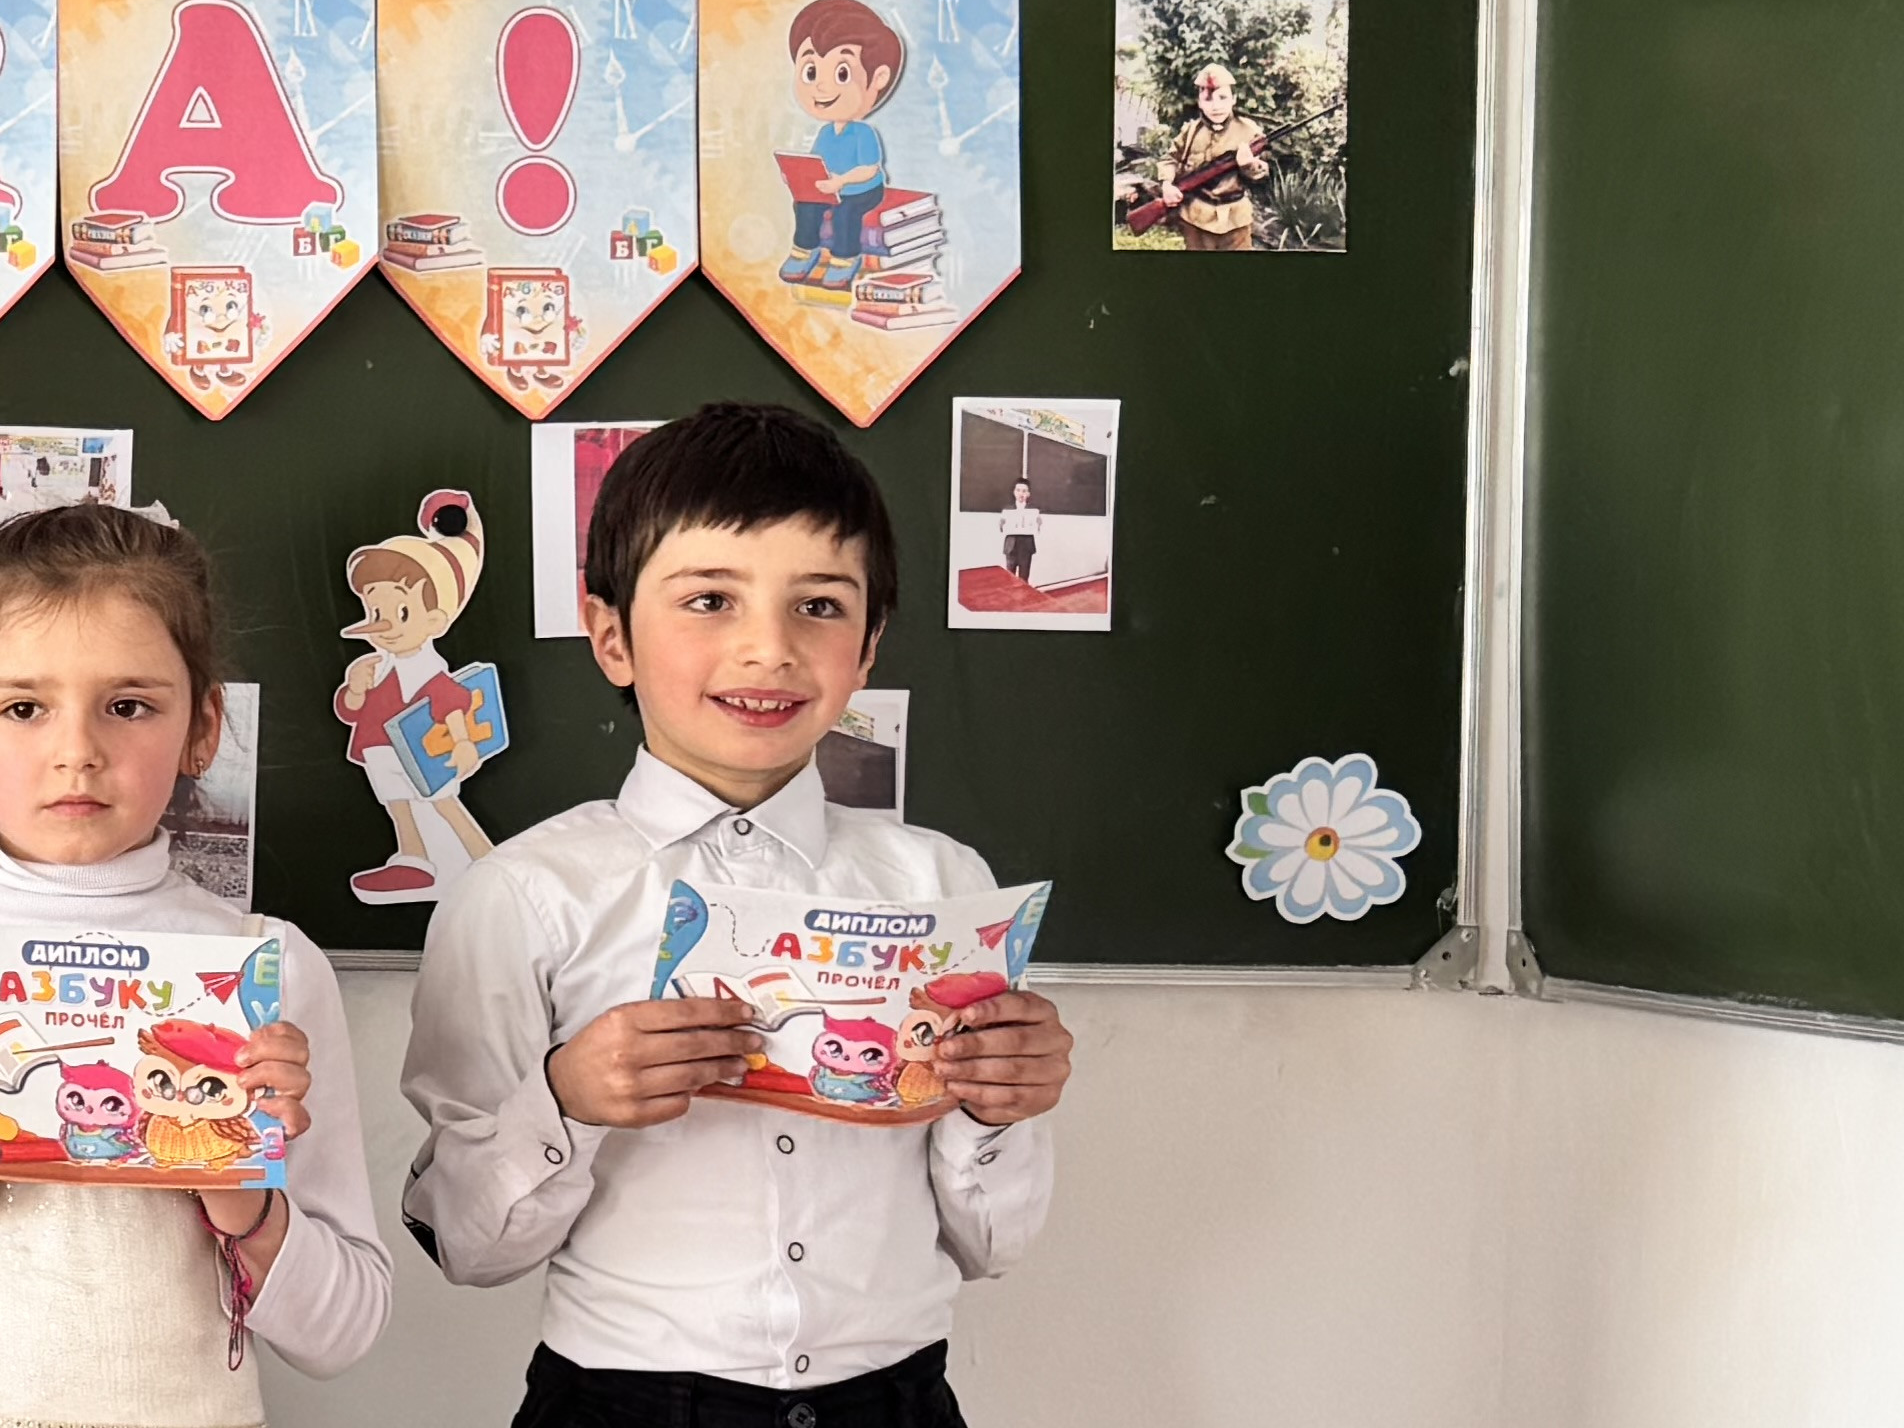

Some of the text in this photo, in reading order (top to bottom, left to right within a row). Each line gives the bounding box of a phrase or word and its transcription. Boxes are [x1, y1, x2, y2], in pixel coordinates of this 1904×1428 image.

[812, 912, 929, 936] ДИПЛОМ
[30, 944, 142, 969] ДИПЛОМ
[770, 932, 954, 972] АЗБУКУ
[816, 971, 900, 992] ПРОЧЁЛ
[44, 1010, 125, 1030] ПРОЧЁЛ
